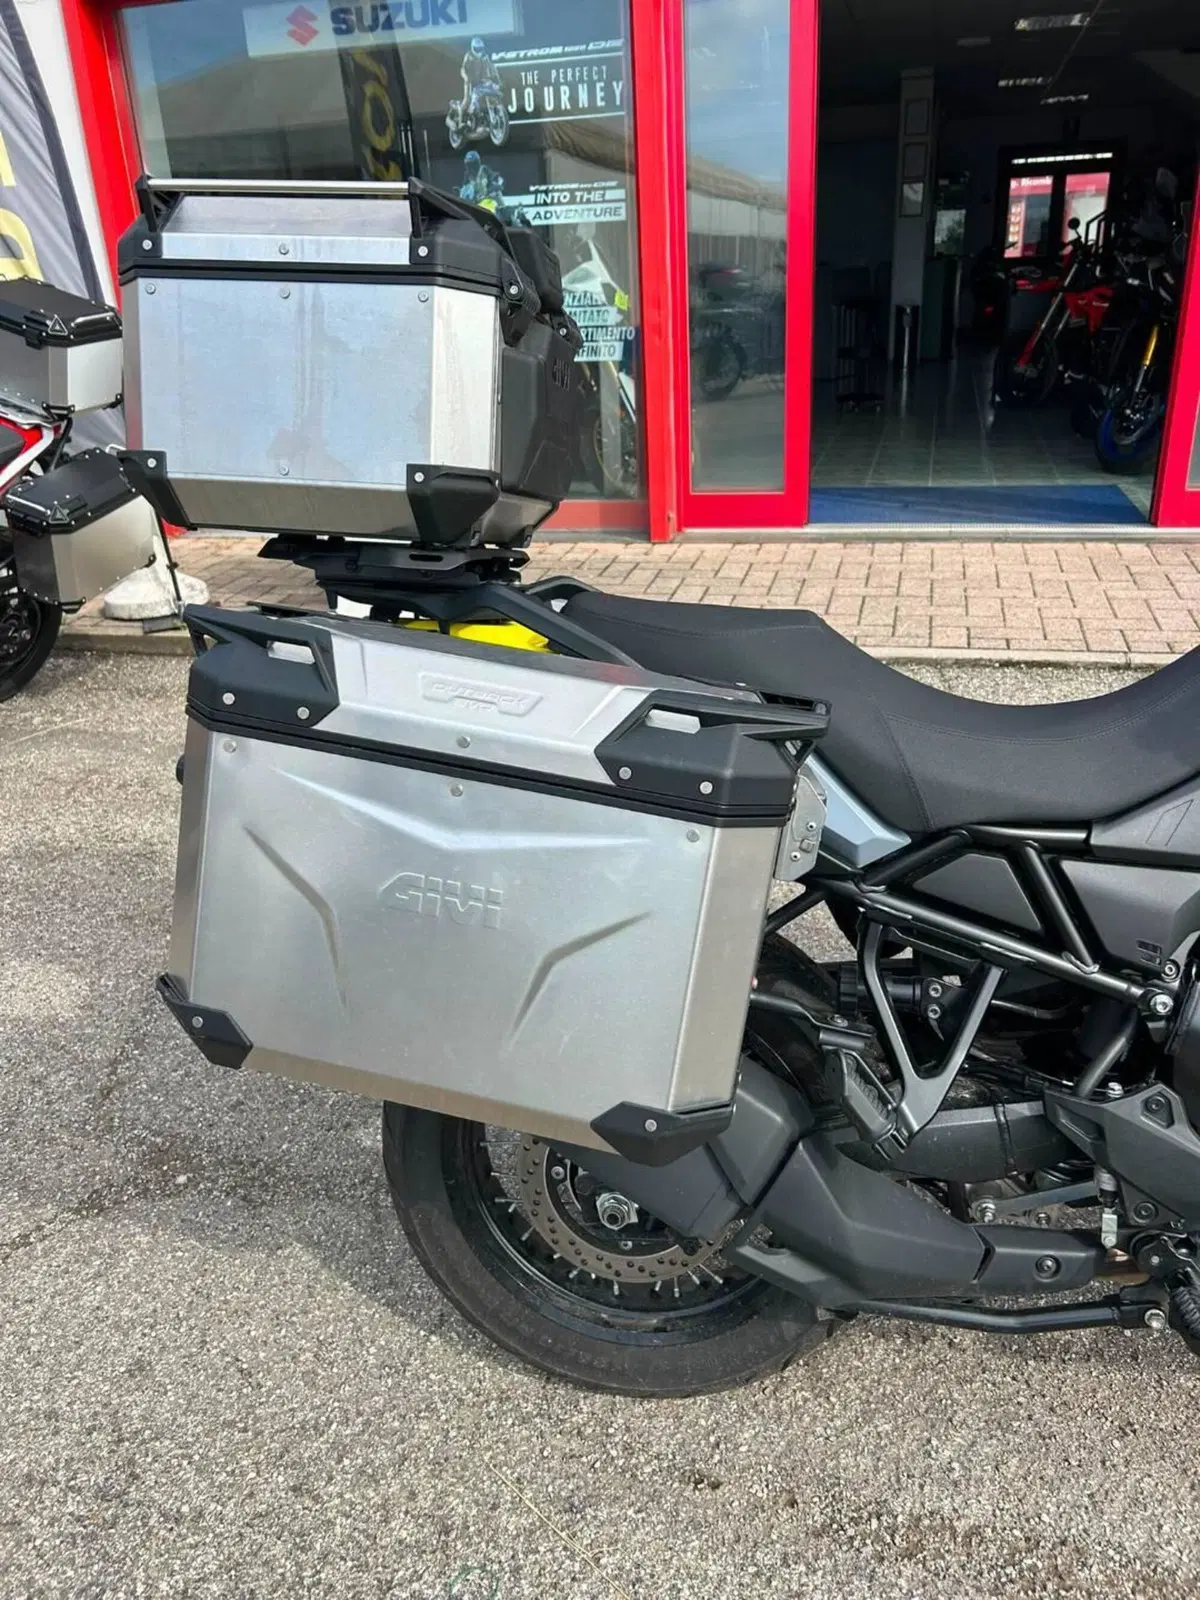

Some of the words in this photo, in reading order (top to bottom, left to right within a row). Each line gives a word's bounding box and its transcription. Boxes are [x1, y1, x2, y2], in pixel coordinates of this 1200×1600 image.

[330, 0, 468, 36] SUZUKI
[521, 70, 540, 86] THE
[551, 65, 608, 84] PERFECT
[507, 80, 623, 114] JOURNEY
[536, 190, 571, 205] INTO
[574, 190, 604, 203] THE
[532, 206, 623, 221] ADVENTURE
[580, 326, 635, 341] RTIMENTO
[377, 871, 504, 930] GIVI
